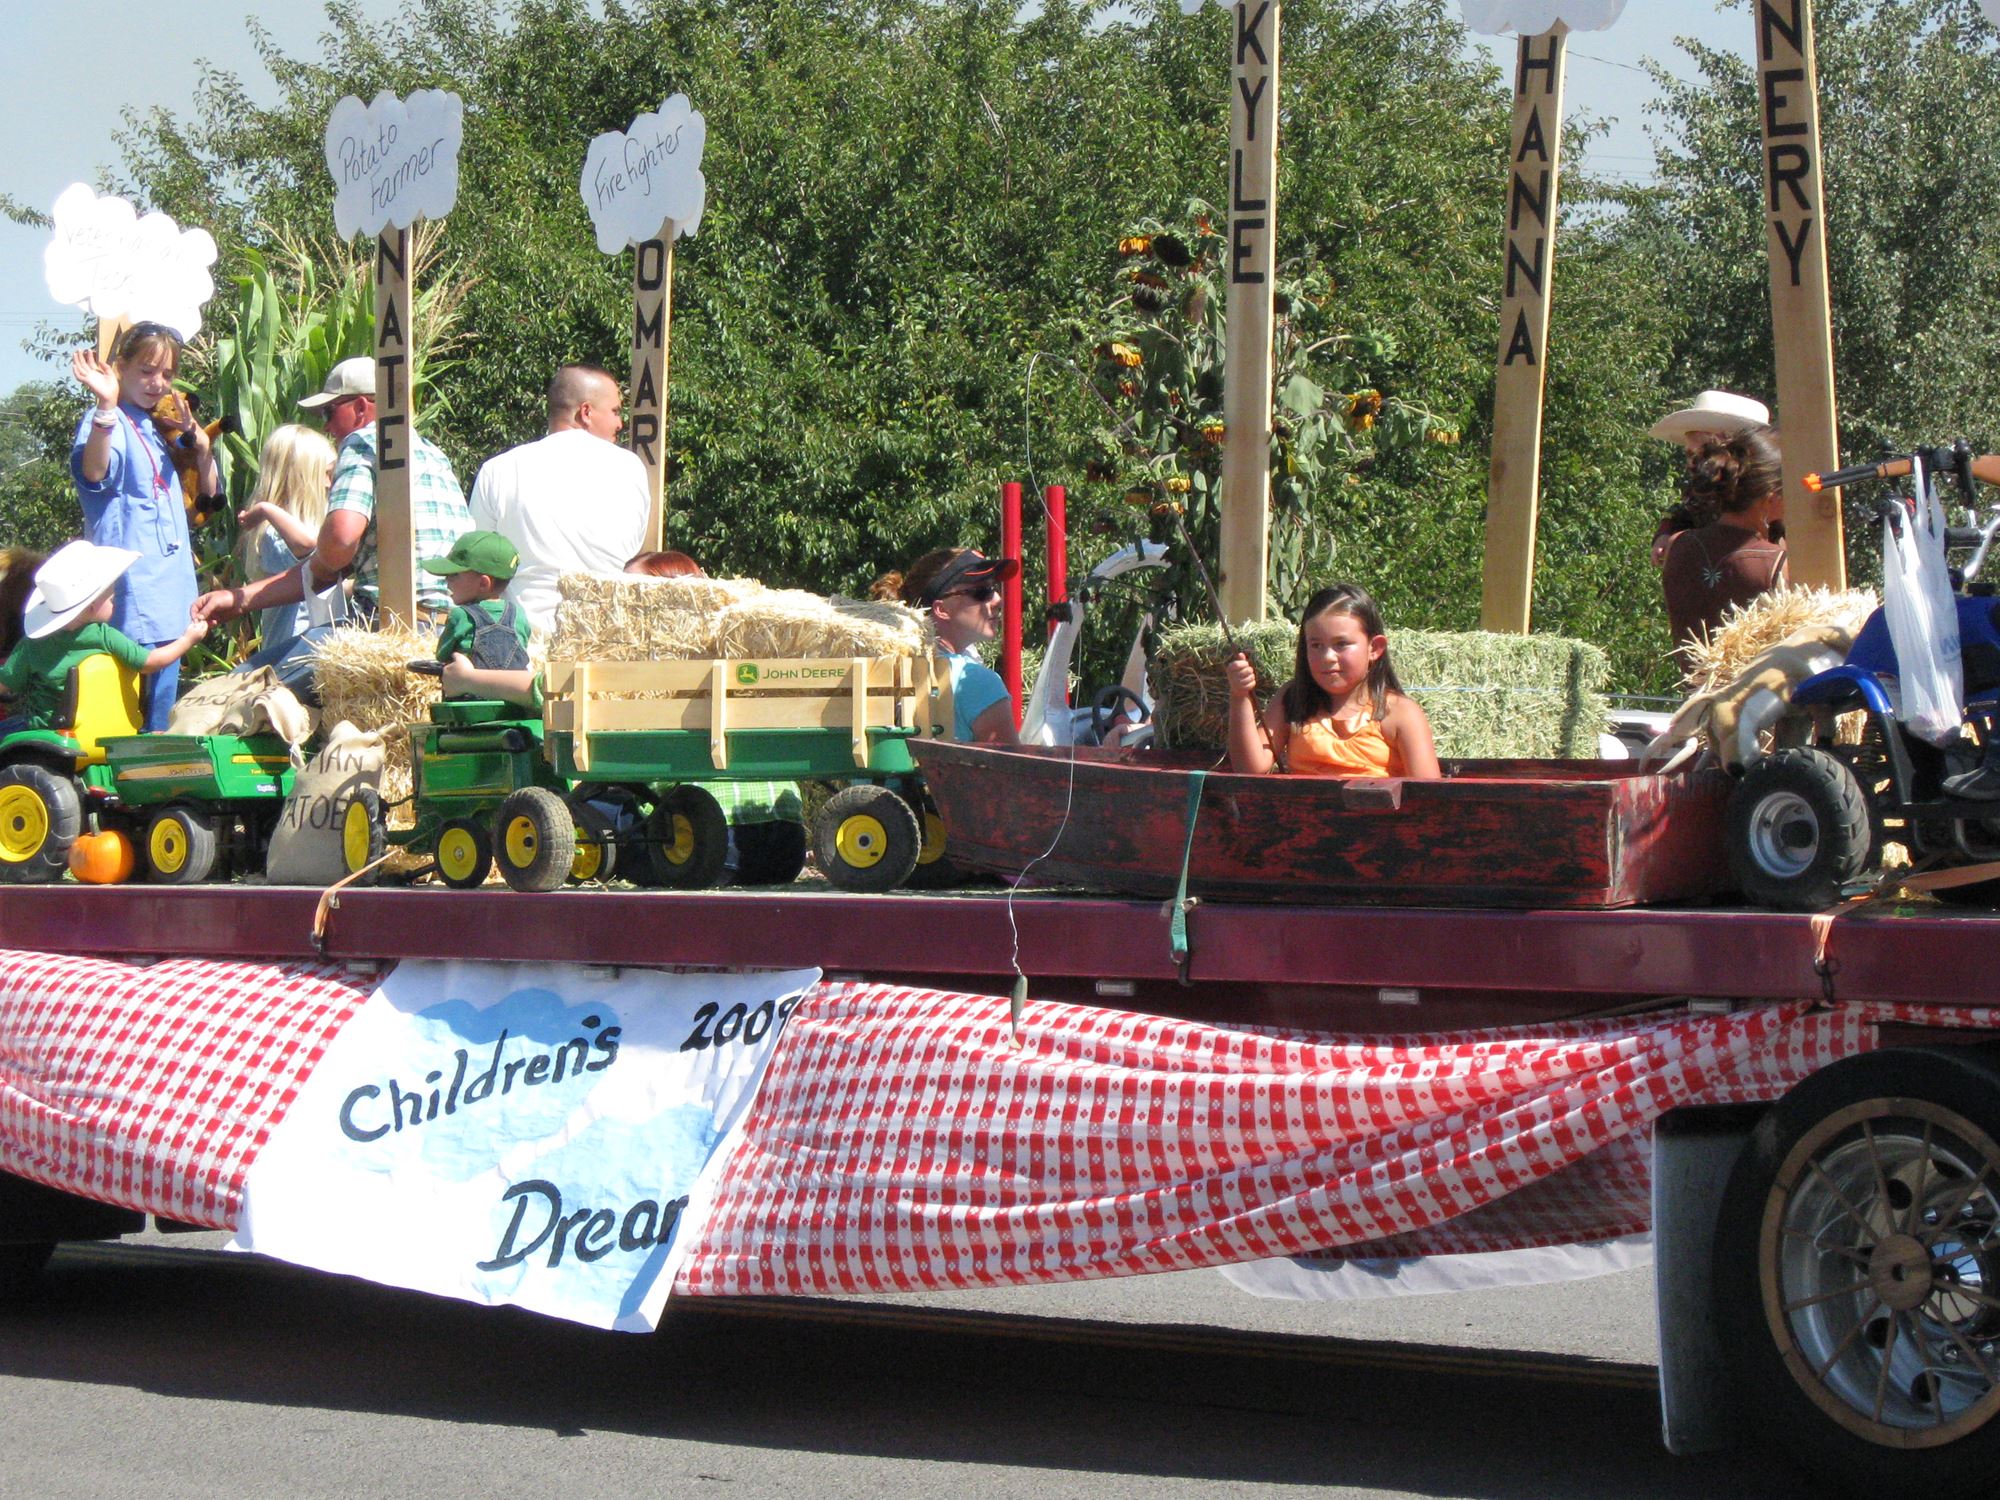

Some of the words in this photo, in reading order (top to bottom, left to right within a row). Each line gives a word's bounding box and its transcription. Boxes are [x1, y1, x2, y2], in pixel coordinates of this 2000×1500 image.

[338, 124, 398, 185] Potato
[370, 138, 444, 217] Farmer
[1232, 1, 1270, 284] KYLE
[1503, 35, 1558, 366] HANNA
[377, 229, 406, 471] NATE
[631, 238, 665, 467] OMAR
[763, 668, 799, 680] JOHN
[801, 667, 845, 679] DEERE
[339, 1014, 623, 1143] Children's
[680, 995, 803, 1053] 2009
